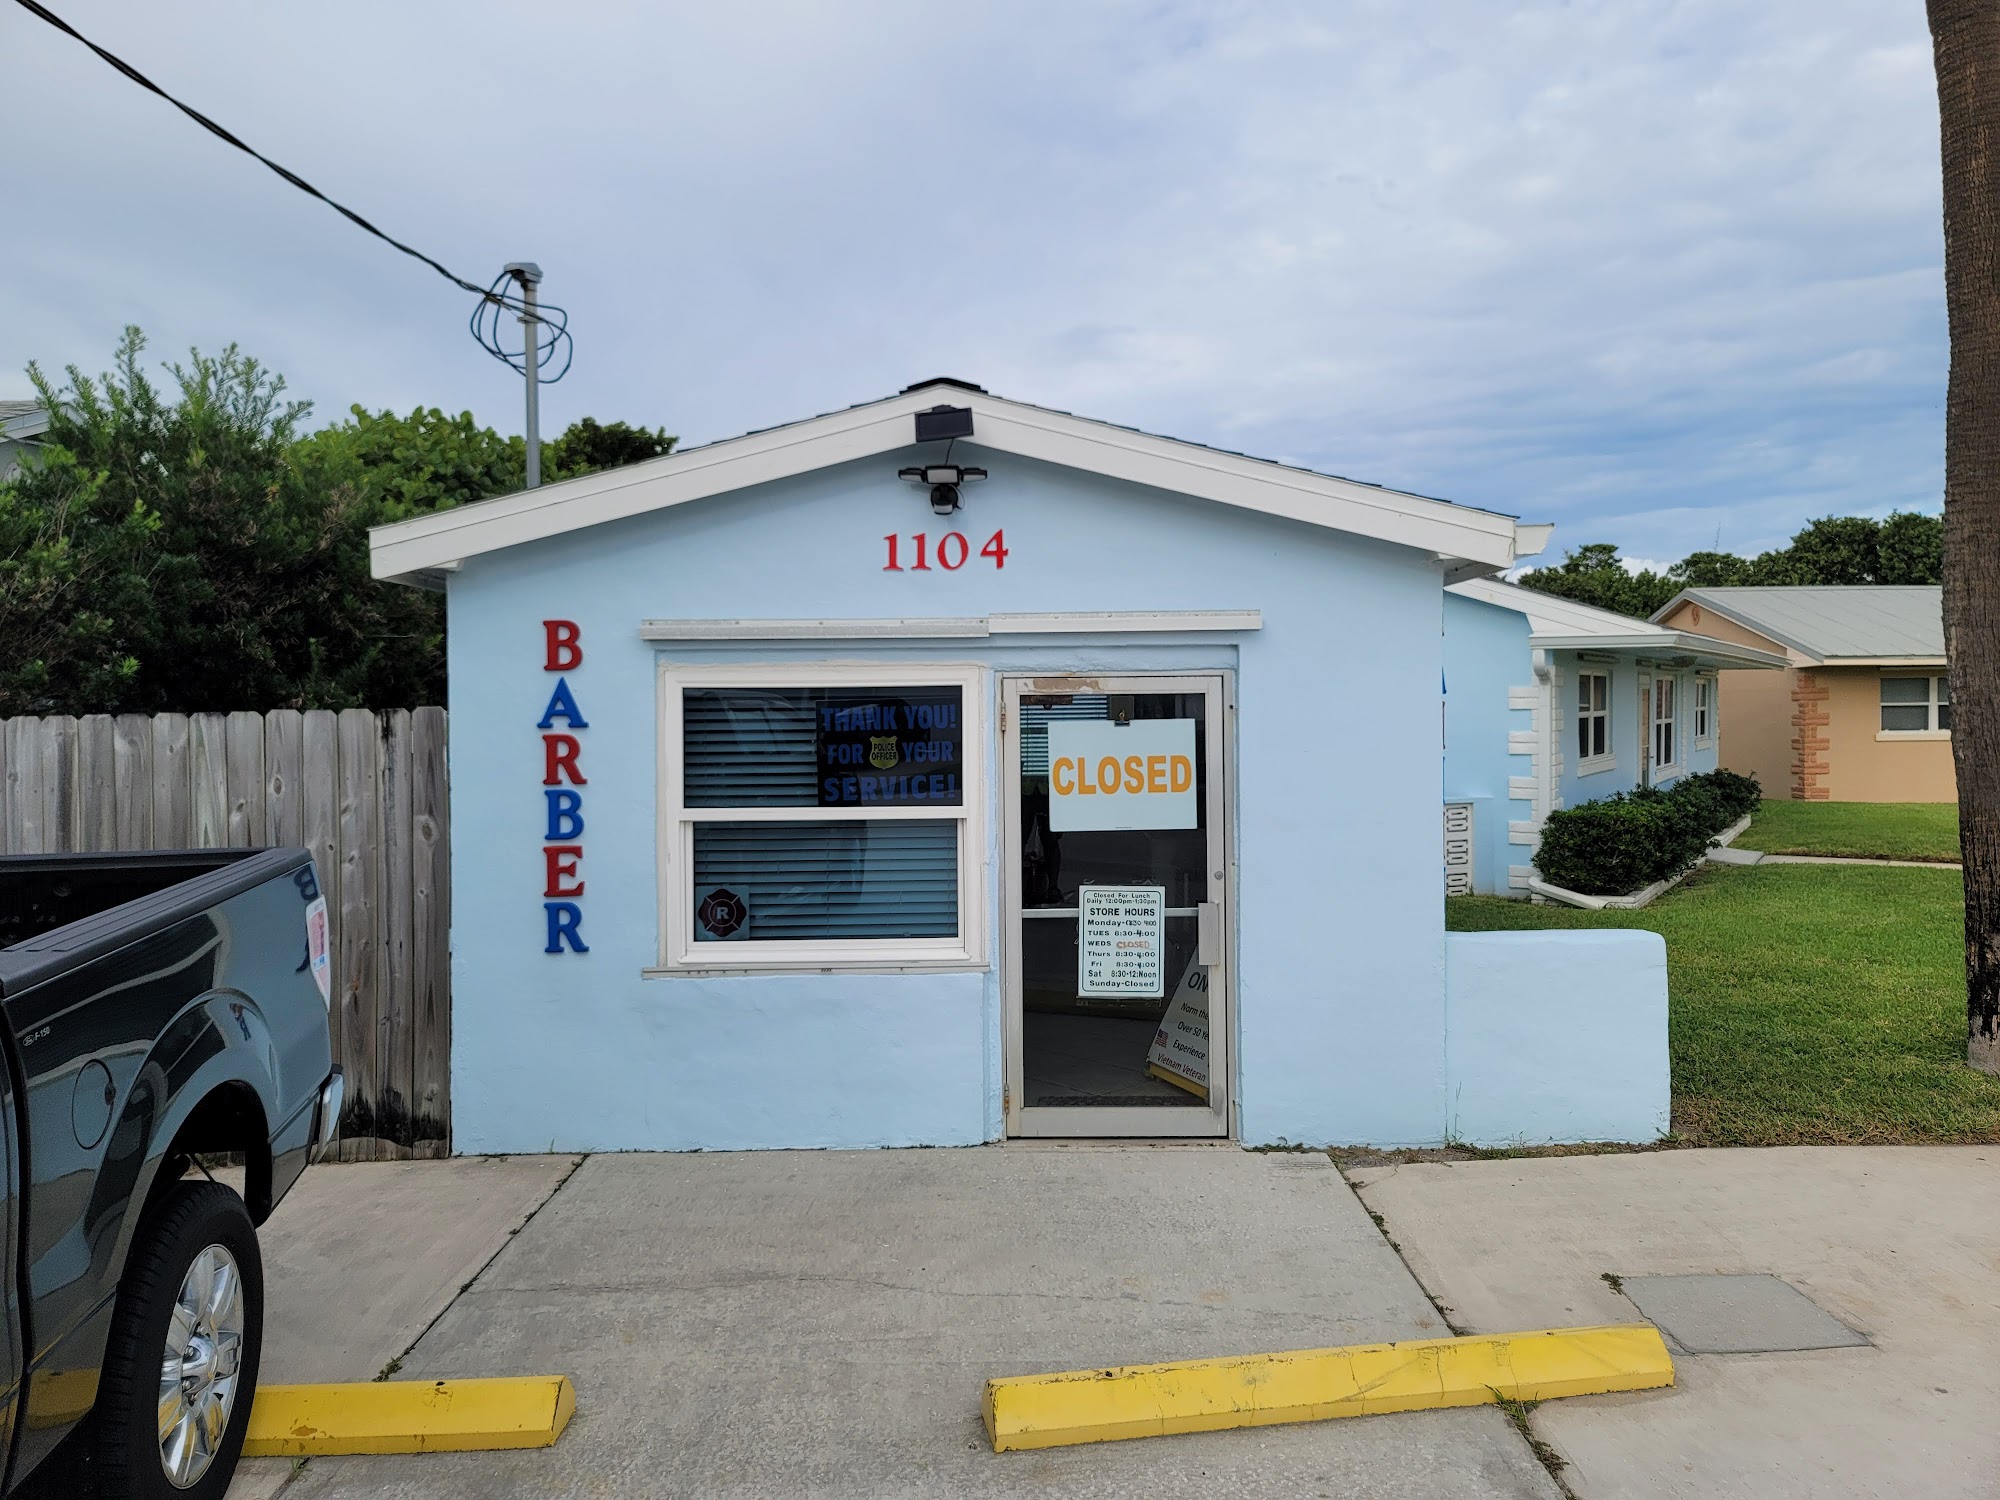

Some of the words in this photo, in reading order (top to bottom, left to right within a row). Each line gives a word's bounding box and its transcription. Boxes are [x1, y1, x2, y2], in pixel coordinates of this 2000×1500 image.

[883, 528, 1009, 571] 1104
[821, 705, 897, 731] THANK
[904, 704, 957, 730] YOU!
[827, 743, 864, 764] FOR
[902, 741, 954, 763] YOUR
[873, 742, 895, 752] POLICE
[871, 752, 897, 761] OFFICER
[1052, 755, 1192, 796] CLOSED
[537, 620, 589, 953] BARBER
[824, 774, 956, 801] SERVICE!
[716, 906, 729, 920] R
[1089, 907, 1120, 916] STORE
[1124, 908, 1155, 916] HOURS
[1114, 929, 1156, 938] 8:30-4:00
[1115, 940, 1150, 949] CLOSED
[1115, 951, 1156, 959] 8:30-4:00
[1115, 961, 1156, 969] 8:30-4:00
[1088, 969, 1102, 978] Sat
[1089, 980, 1154, 988] Sunday-Closed
[1180, 1002, 1198, 1016] Norm
[1177, 1021, 1192, 1034] Over
[1192, 1026, 1201, 1037] 50
[1172, 1039, 1206, 1060] Experience
[1157, 1052, 1181, 1071] Vietnam
[1182, 1064, 1206, 1082] Veteran
